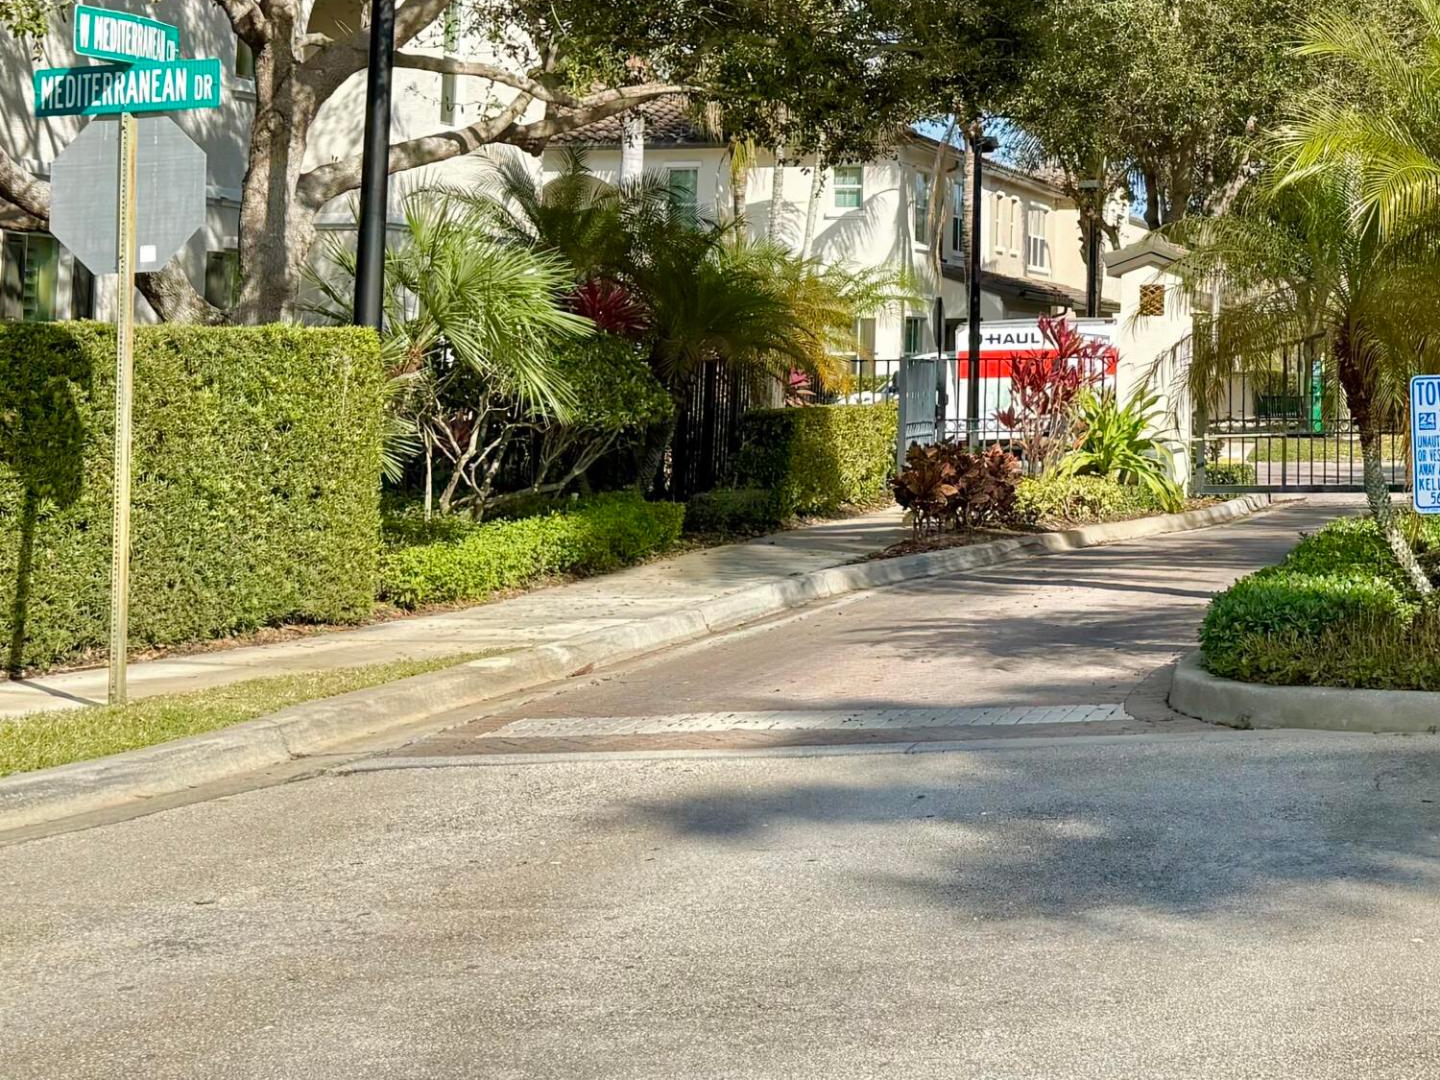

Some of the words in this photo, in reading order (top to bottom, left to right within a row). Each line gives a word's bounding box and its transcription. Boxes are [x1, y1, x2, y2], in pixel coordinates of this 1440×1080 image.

[80, 13, 90, 48] W
[94, 15, 166, 62] MEDITERRANEAN
[41, 68, 187, 110] MEDITERRANEAN
[194, 74, 213, 100] DR
[1419, 413, 1434, 425] 24
[1418, 449, 1427, 461] OR
[1418, 463, 1436, 476] AWAY
